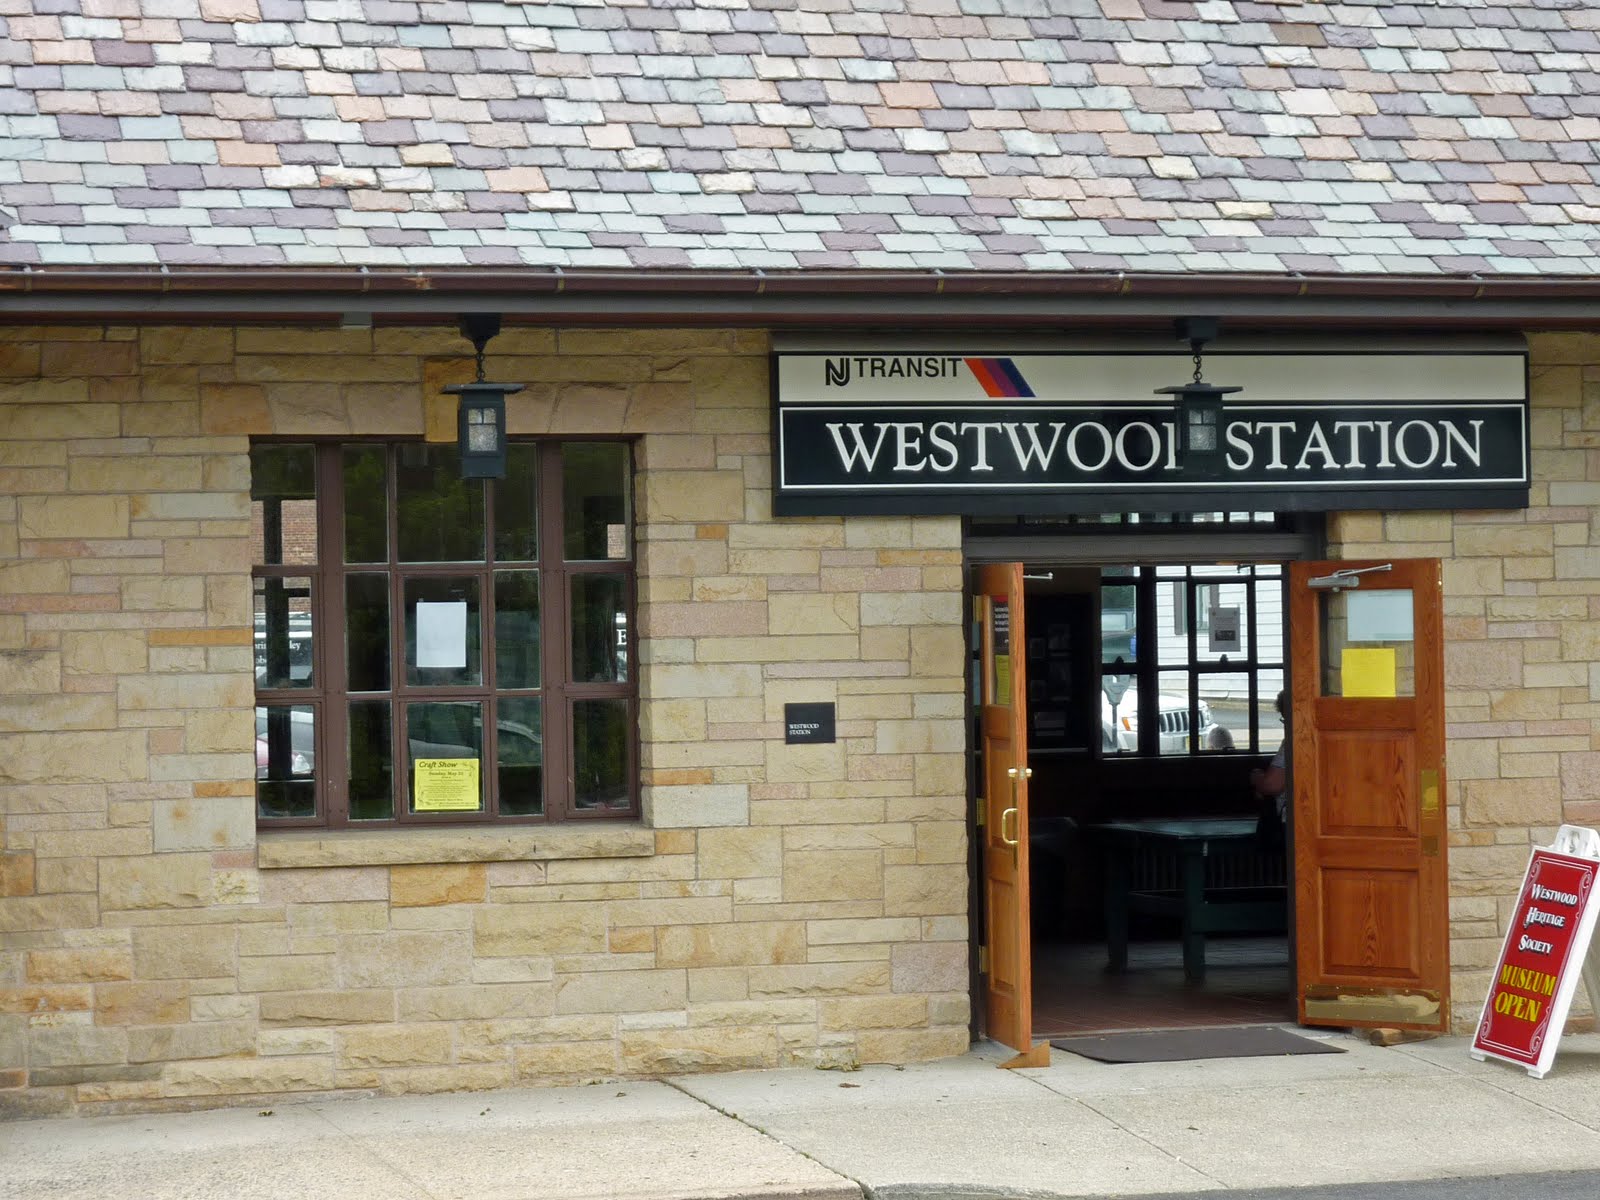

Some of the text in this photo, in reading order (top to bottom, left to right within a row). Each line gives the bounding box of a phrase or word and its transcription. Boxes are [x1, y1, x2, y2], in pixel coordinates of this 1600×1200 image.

[825, 357, 963, 387] NJ TRANSIT
[1226, 419, 1485, 471] STATION
[419, 761, 437, 769] Craft
[1531, 883, 1578, 906] WESTWOOD
[1525, 906, 1566, 928] HERITAGE
[1518, 934, 1553, 954] SOCIETY
[1499, 964, 1558, 996] MUSEUM
[1495, 991, 1542, 1022] OPEN
